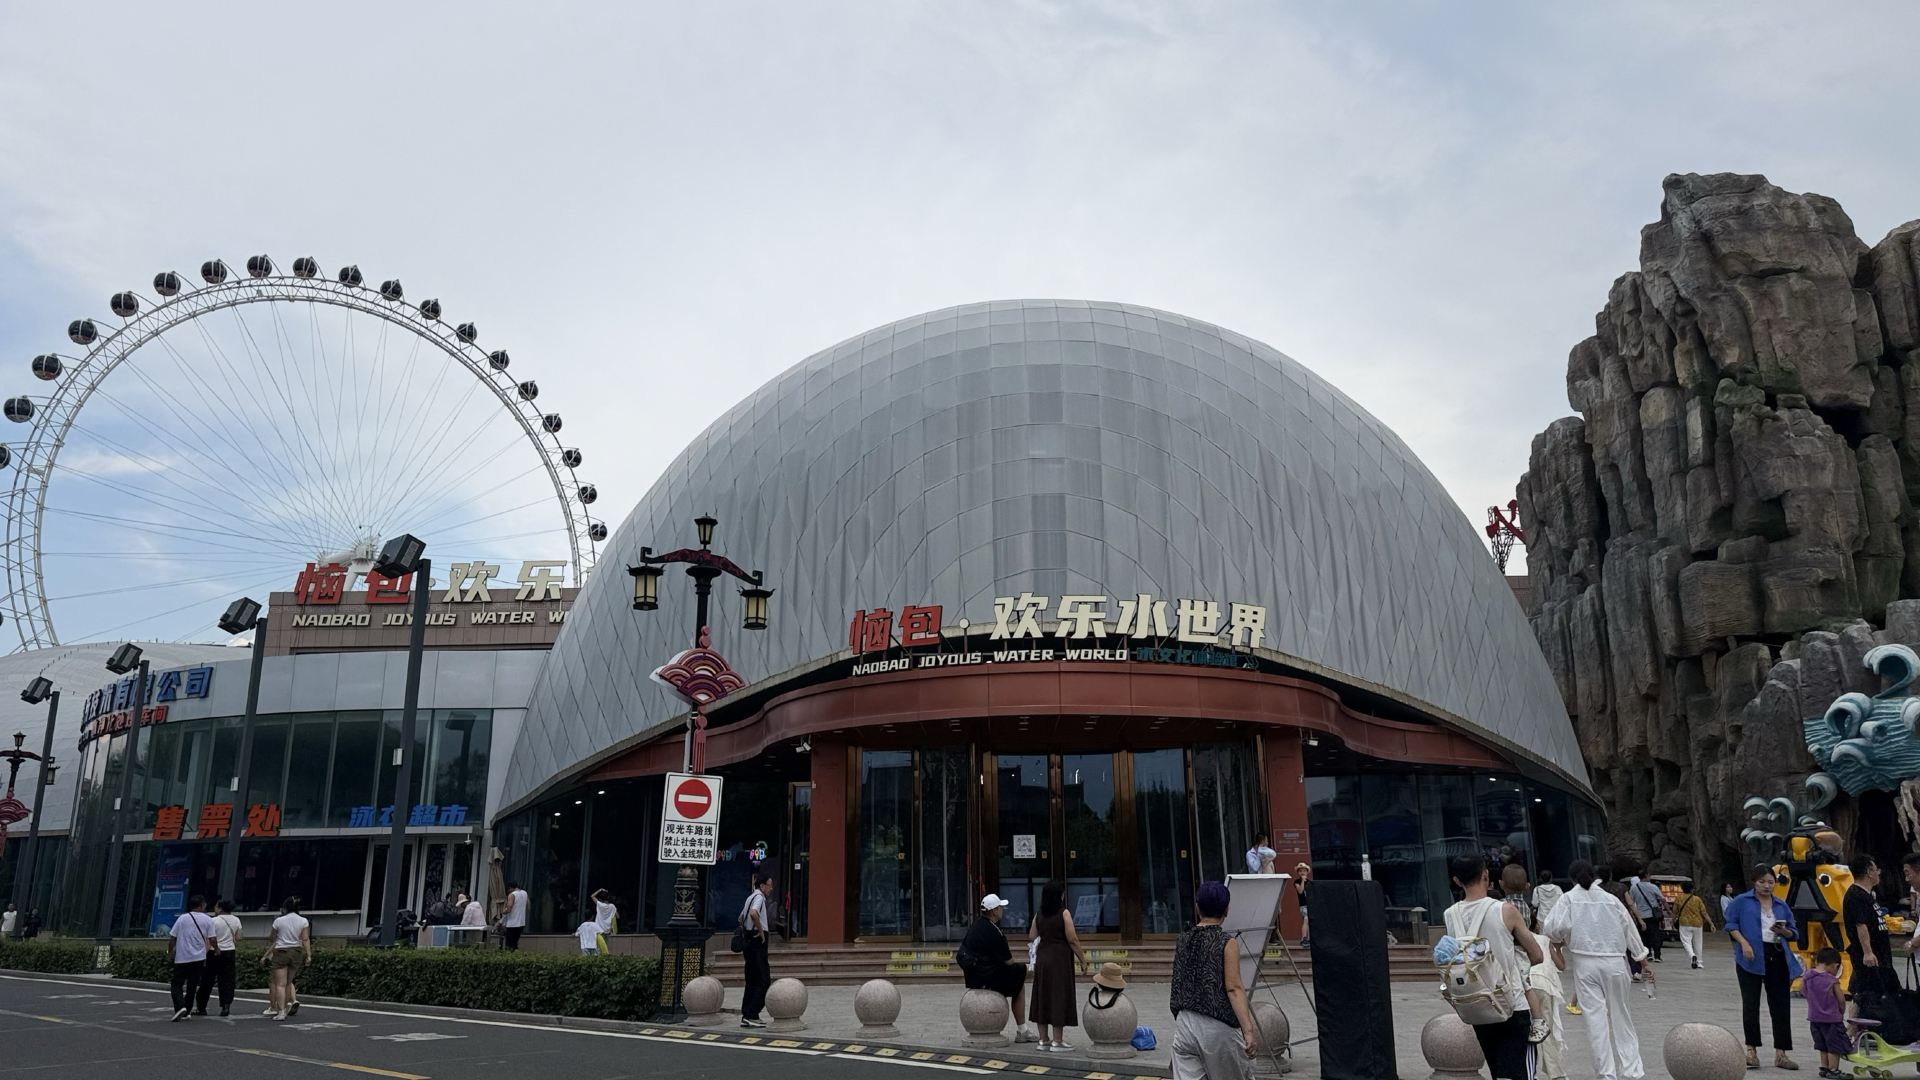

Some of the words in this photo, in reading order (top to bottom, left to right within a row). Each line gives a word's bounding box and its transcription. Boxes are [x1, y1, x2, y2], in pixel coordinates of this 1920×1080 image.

[292, 614, 371, 627] NAOBAO
[471, 611, 535, 625] WATER
[852, 658, 910, 676] NAOBAO
[918, 652, 982, 668] JOYOUS
[993, 649, 1054, 662] WATER
[1065, 648, 1128, 661] WORLD
[152, 802, 281, 840] 售票处
[665, 823, 713, 836] 观光车路线
[664, 836, 713, 849] 禁止社会车辆
[663, 848, 712, 860] 驶入全线禁停
